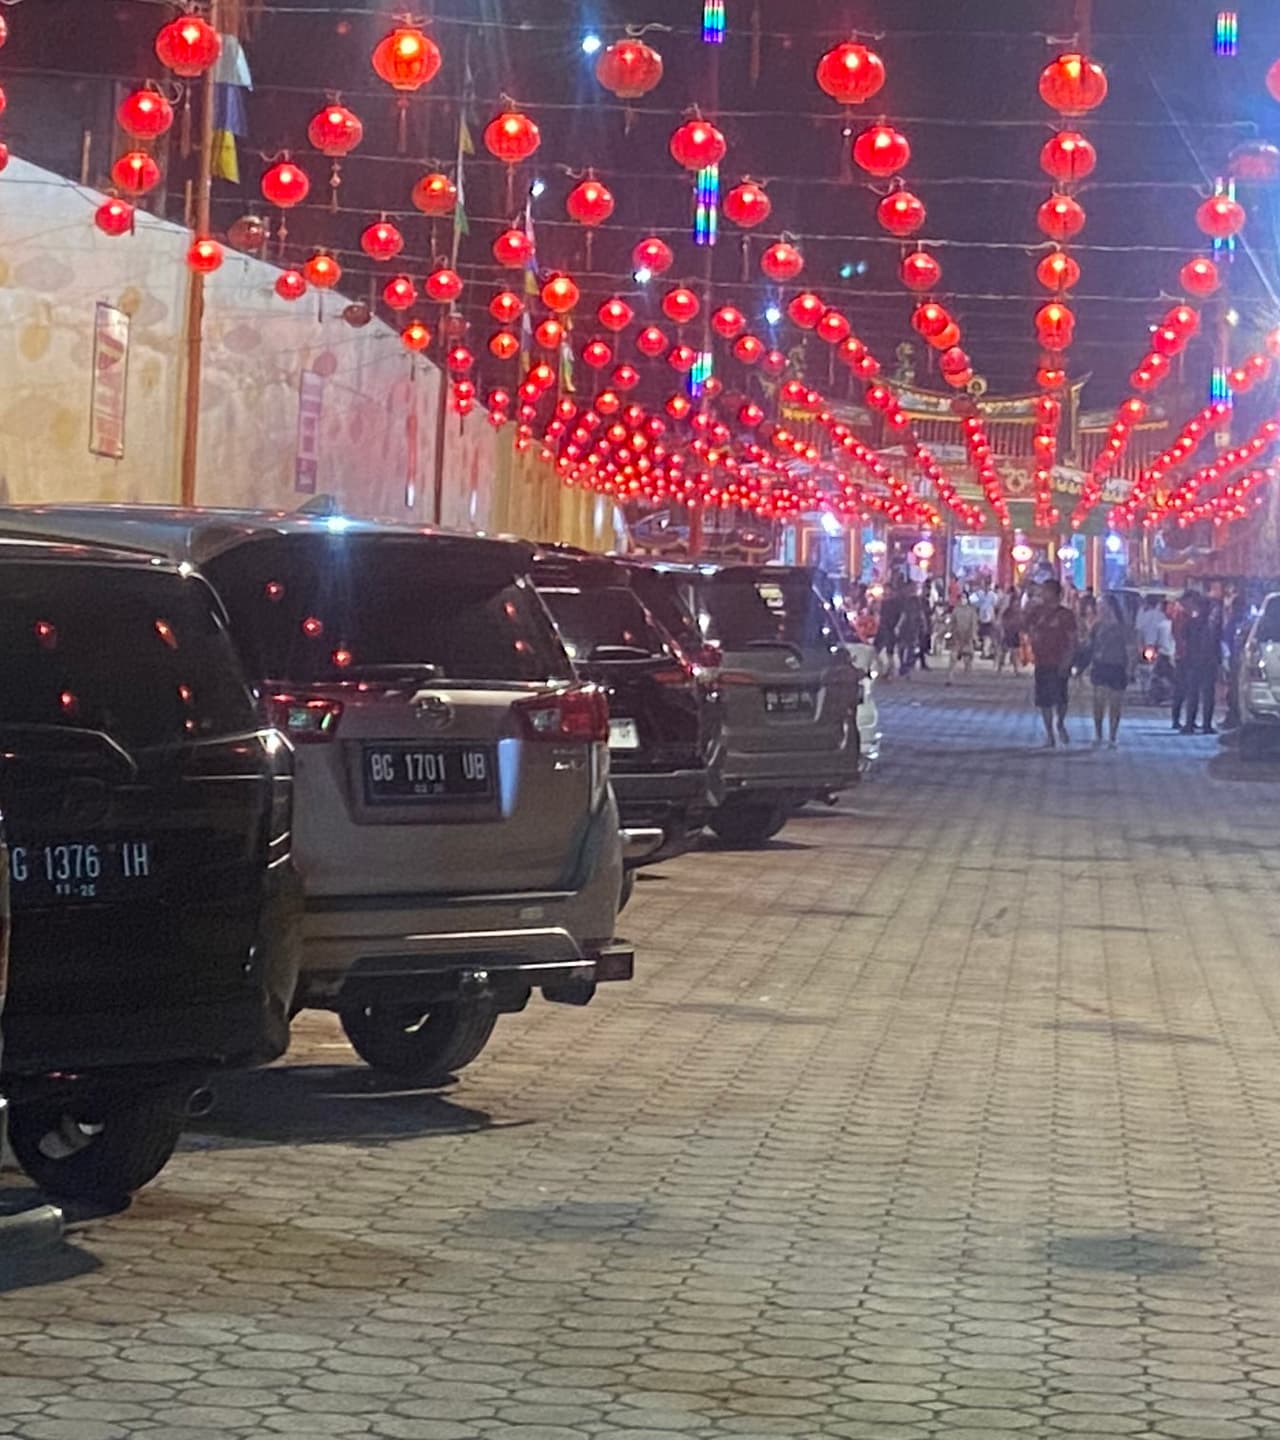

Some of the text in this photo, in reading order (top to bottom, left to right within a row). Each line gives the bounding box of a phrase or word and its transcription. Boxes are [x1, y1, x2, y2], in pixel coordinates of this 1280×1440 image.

[371, 753, 486, 781] BG 1701 UB
[44, 844, 101, 880] 1376
[123, 843, 149, 877] IH
